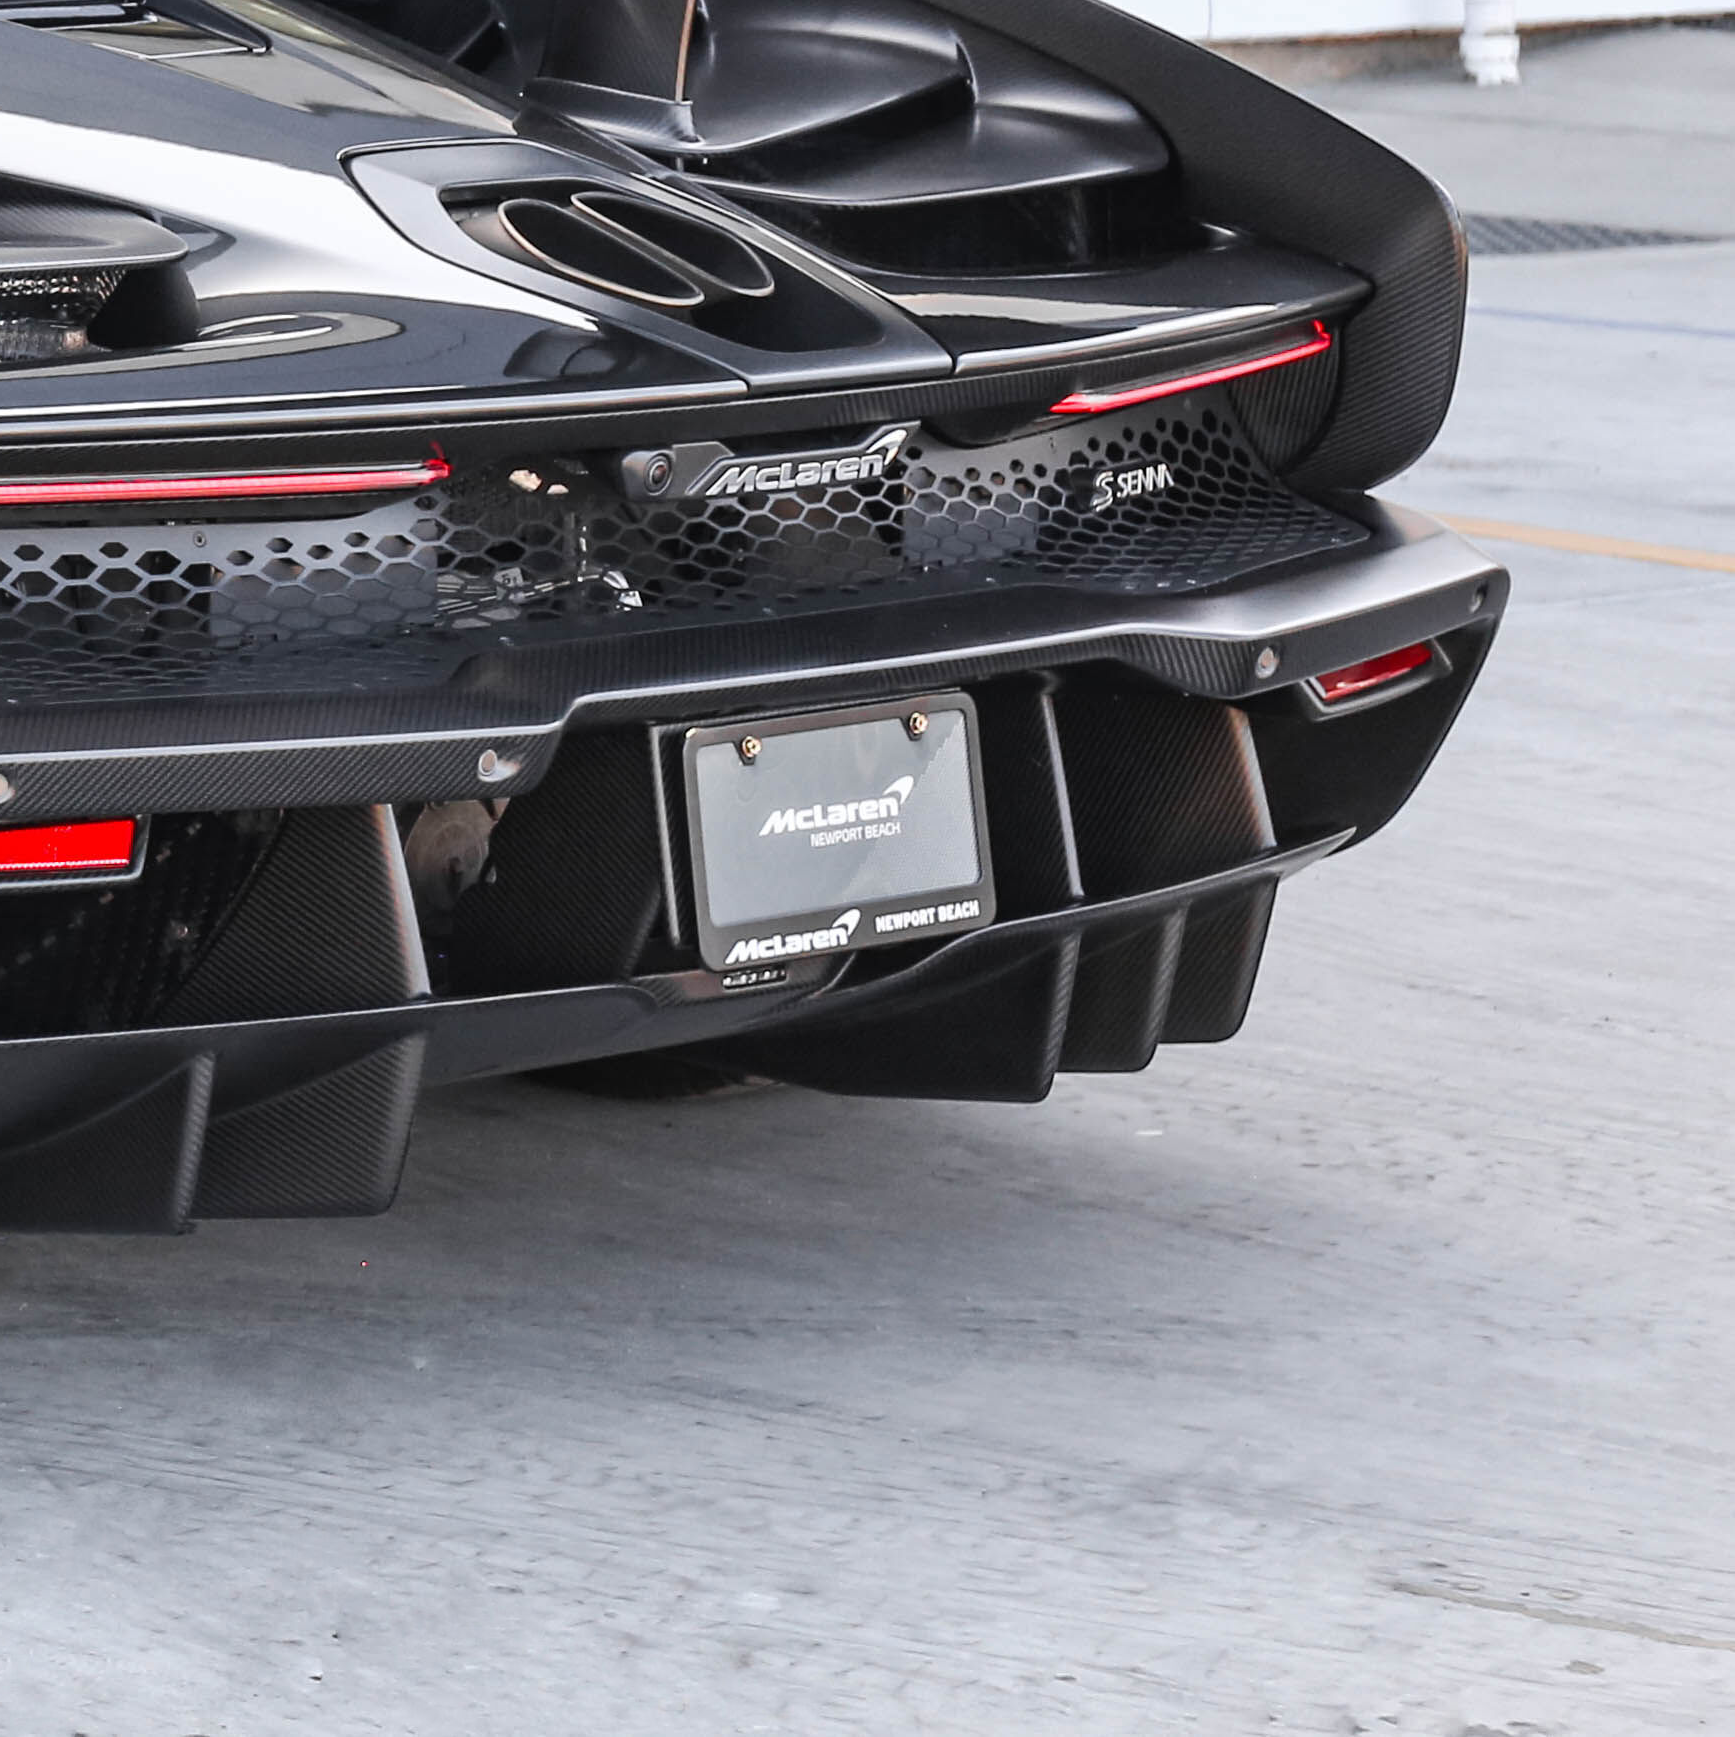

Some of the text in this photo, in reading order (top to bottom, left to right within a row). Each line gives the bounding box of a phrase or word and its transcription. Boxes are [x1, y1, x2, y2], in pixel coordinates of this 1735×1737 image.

[705, 454, 884, 496] McLaren
[1115, 463, 1175, 499] SENNA
[758, 797, 899, 837] McLaren
[810, 822, 902, 847] NEWPORT BEACH
[875, 900, 980, 933] NEWPORT BEACH
[724, 925, 849, 965] McLaren
